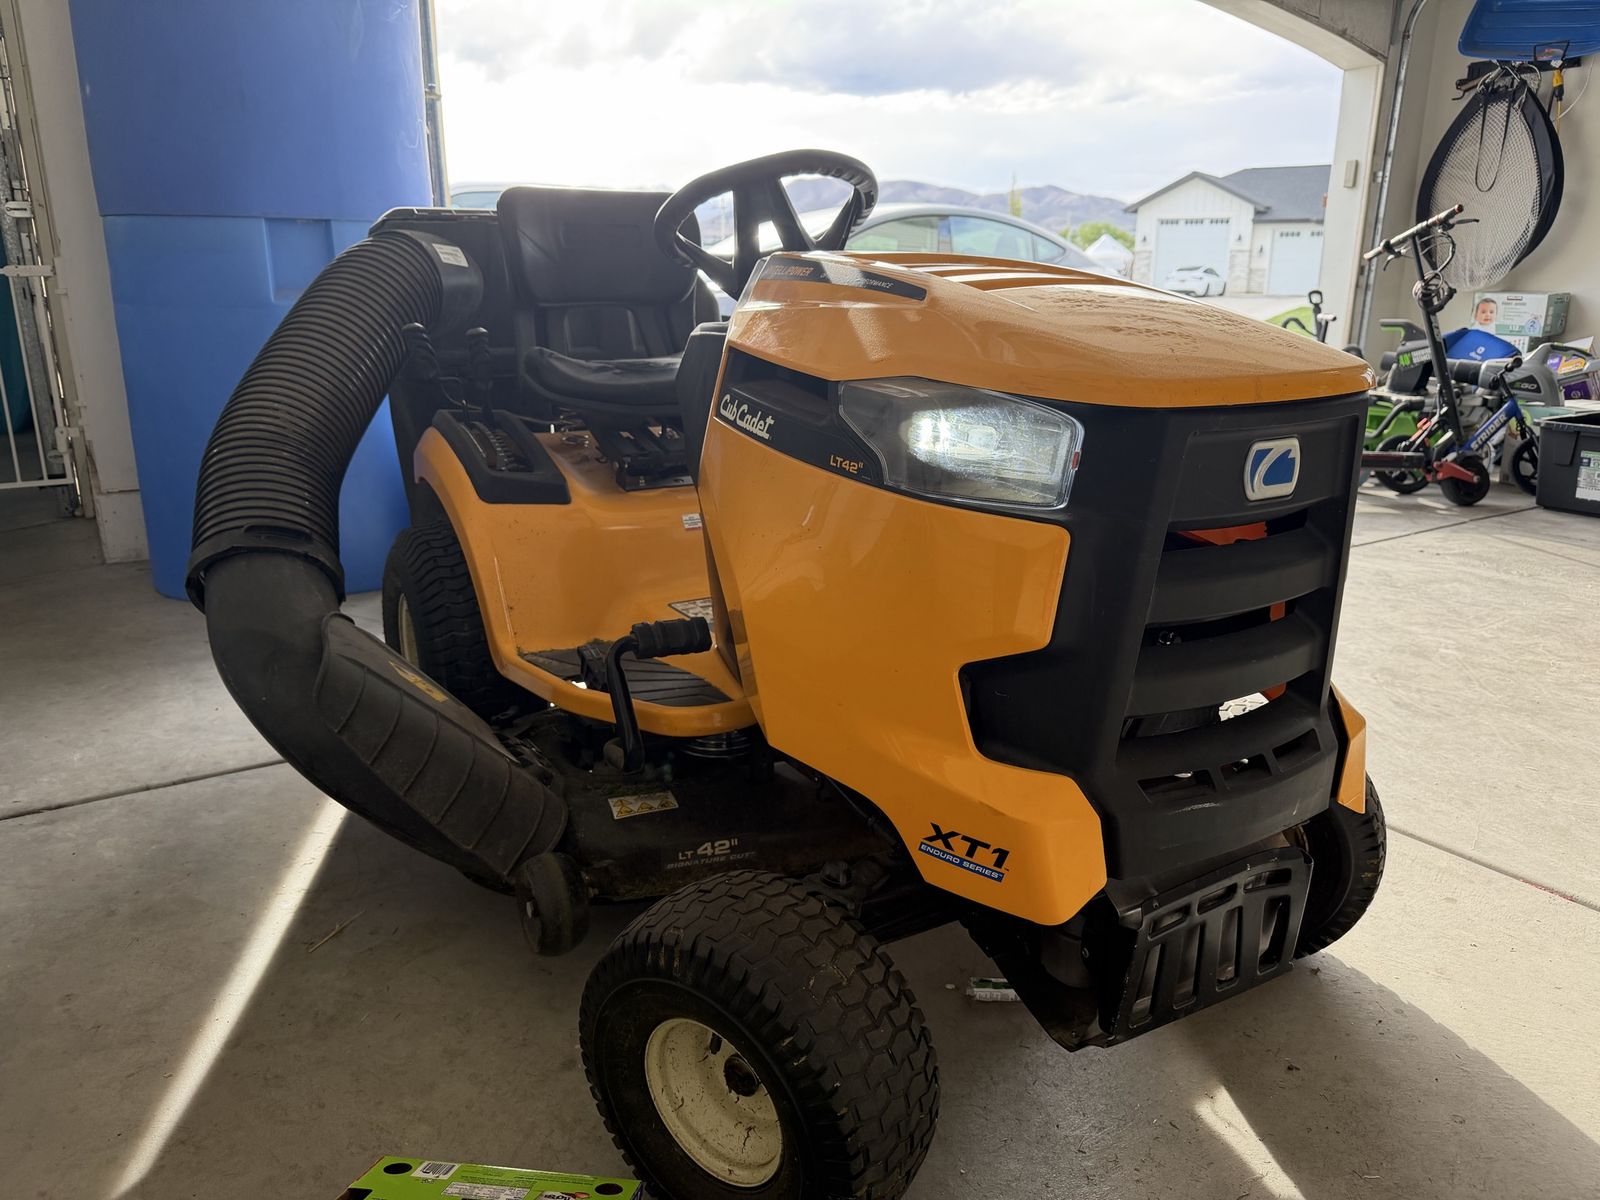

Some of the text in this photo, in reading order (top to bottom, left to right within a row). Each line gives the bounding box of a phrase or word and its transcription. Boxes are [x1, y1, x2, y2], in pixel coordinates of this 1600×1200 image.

[1515, 379, 1537, 391] EGO
[720, 394, 775, 440] Cub Cadet
[1471, 411, 1507, 450] STRIDER
[830, 455, 864, 475] LT42"
[678, 837, 739, 861] LT 42"
[922, 821, 1010, 869] XT1
[667, 851, 752, 870] SIGNATURE CUT
[920, 843, 999, 879] ENDURO SERIES
